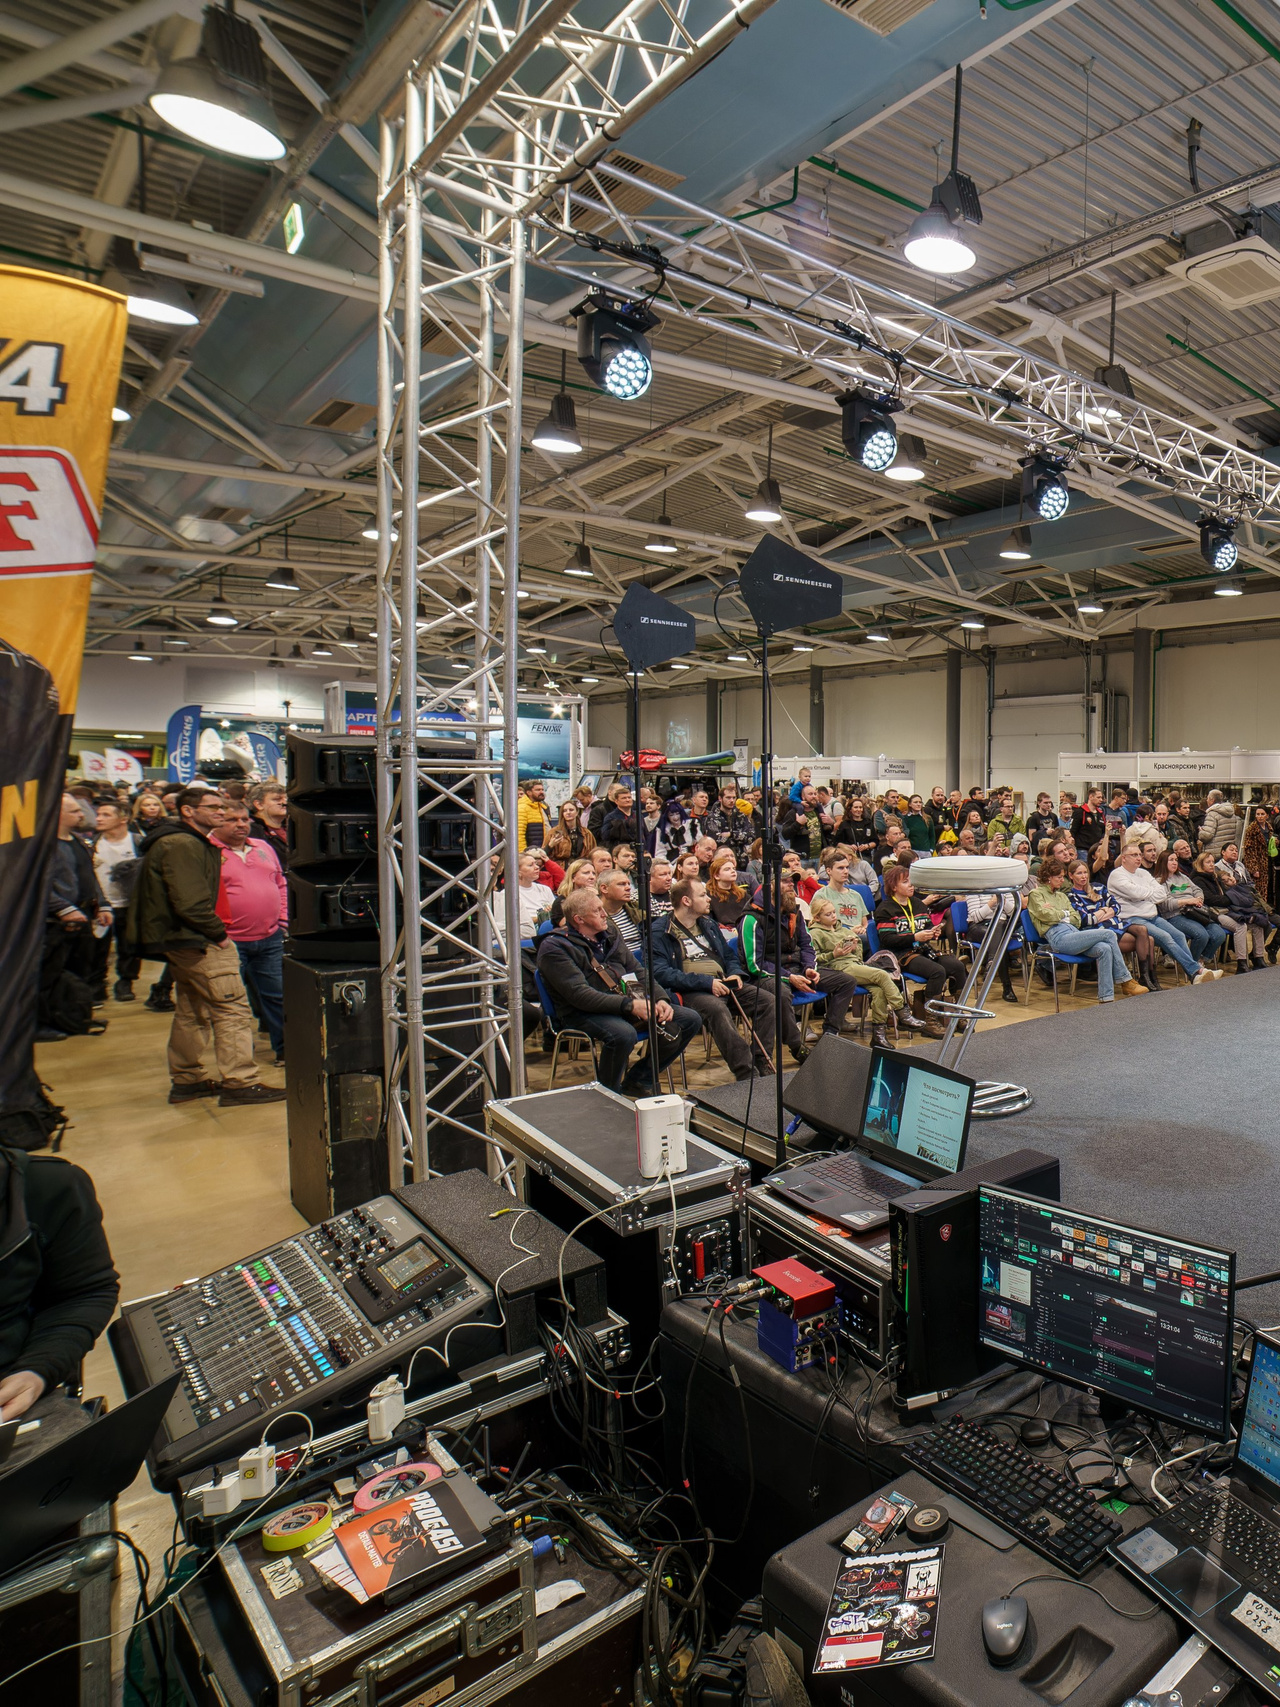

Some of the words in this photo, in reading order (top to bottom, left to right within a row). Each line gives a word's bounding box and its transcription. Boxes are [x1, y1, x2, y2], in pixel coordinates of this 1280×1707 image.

[785, 577, 833, 589] SENNHEISER
[650, 619, 688, 628] SENNHEISER
[1154, 762, 1197, 771] Красноярские
[1198, 763, 1215, 771] унты
[357, 1530, 374, 1552] DETAILS
[367, 1546, 384, 1569] MATTER
[265, 1559, 299, 1595] FRONT
